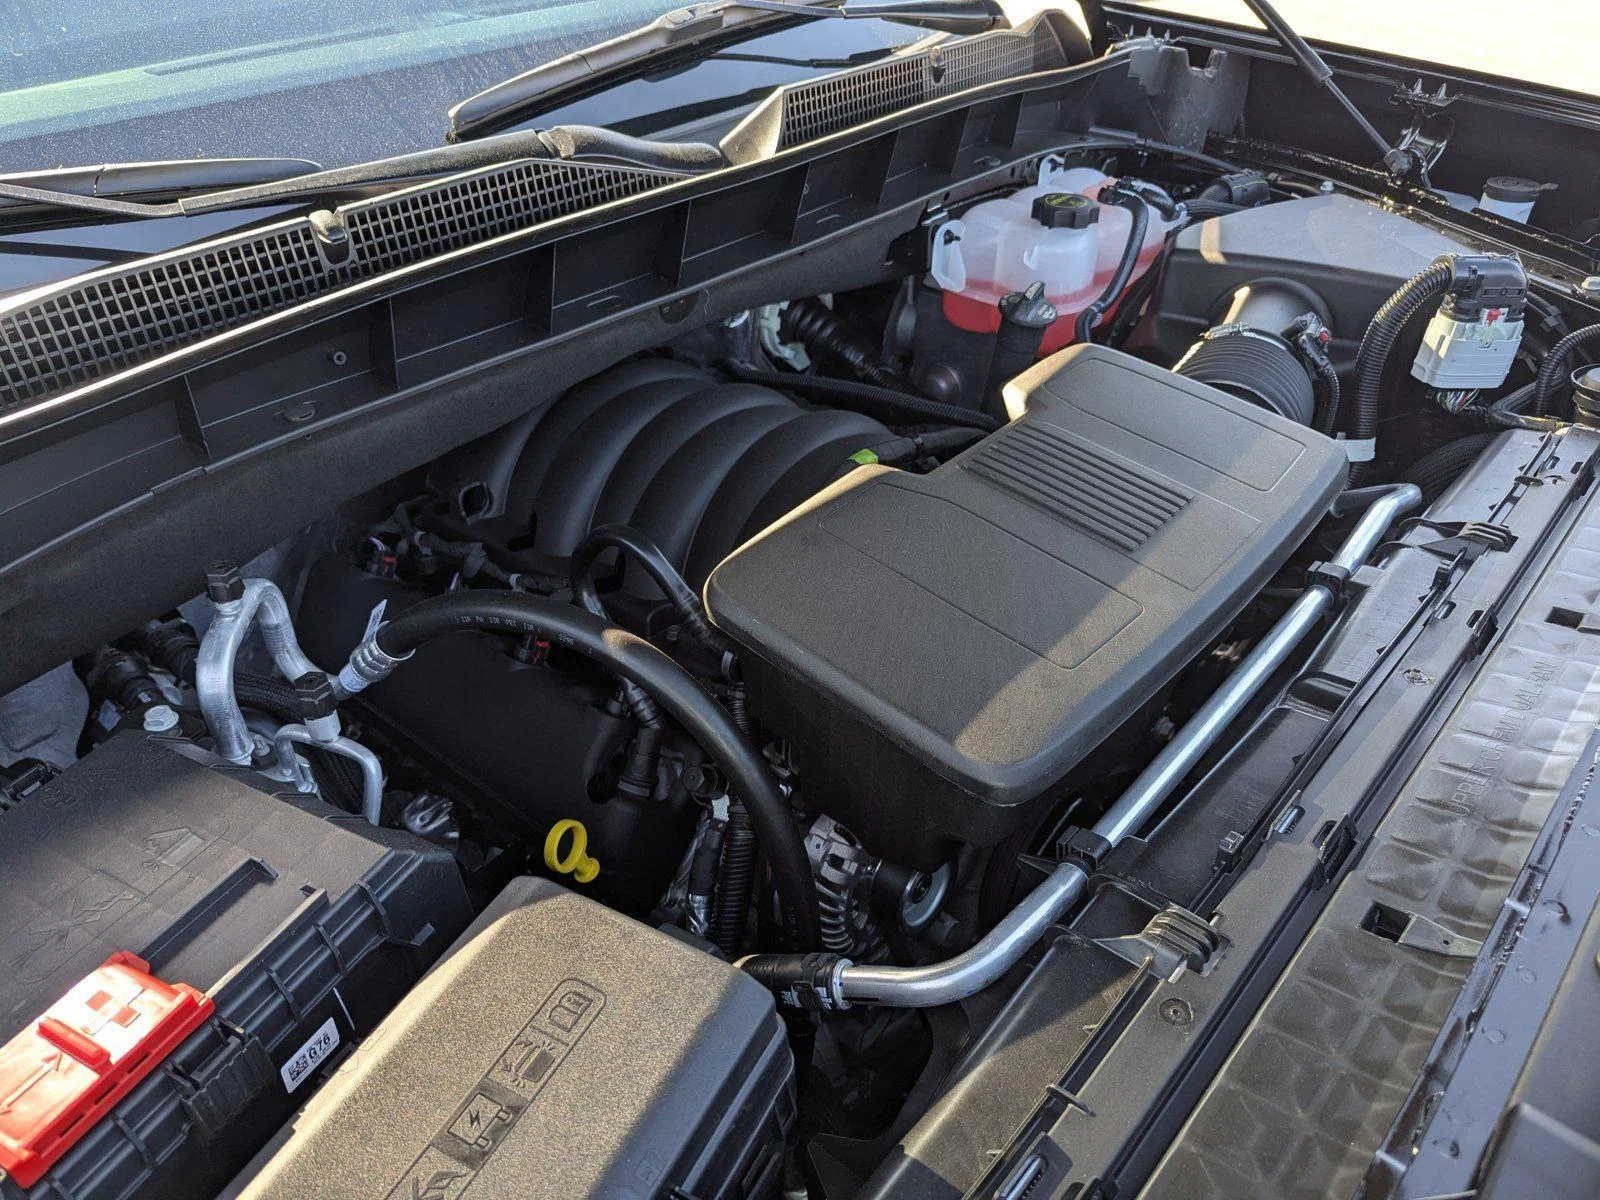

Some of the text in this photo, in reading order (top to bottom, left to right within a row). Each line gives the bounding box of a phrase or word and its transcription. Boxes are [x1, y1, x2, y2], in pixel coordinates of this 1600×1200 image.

[1450, 763, 1495, 817] UPPER
[1503, 688, 1542, 721] DUAL
[1526, 661, 1557, 689] FAN
[308, 1033, 331, 1059] G76
